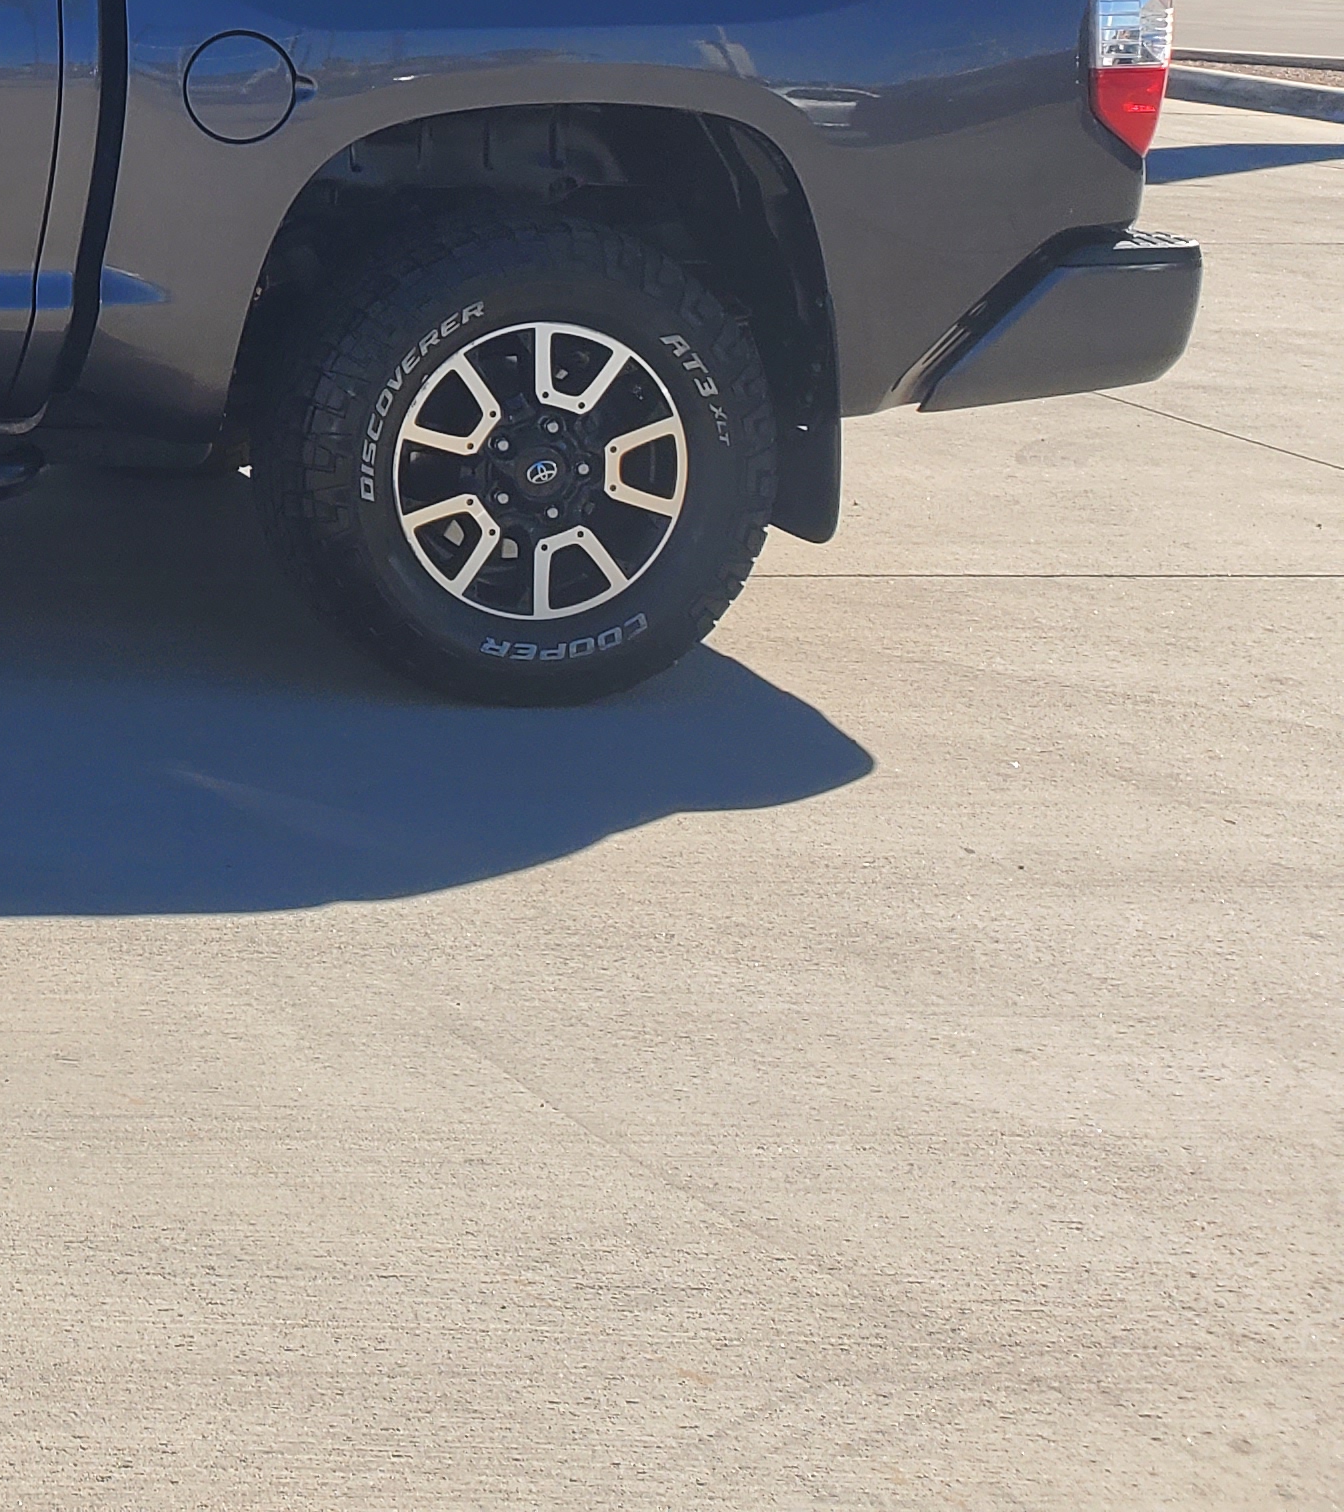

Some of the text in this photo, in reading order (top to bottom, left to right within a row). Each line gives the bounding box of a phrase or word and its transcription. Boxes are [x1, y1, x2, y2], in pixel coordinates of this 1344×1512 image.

[360, 301, 485, 502] DISCOVERER
[659, 334, 730, 446] AT3 XLT
[480, 612, 648, 661] COOPER
